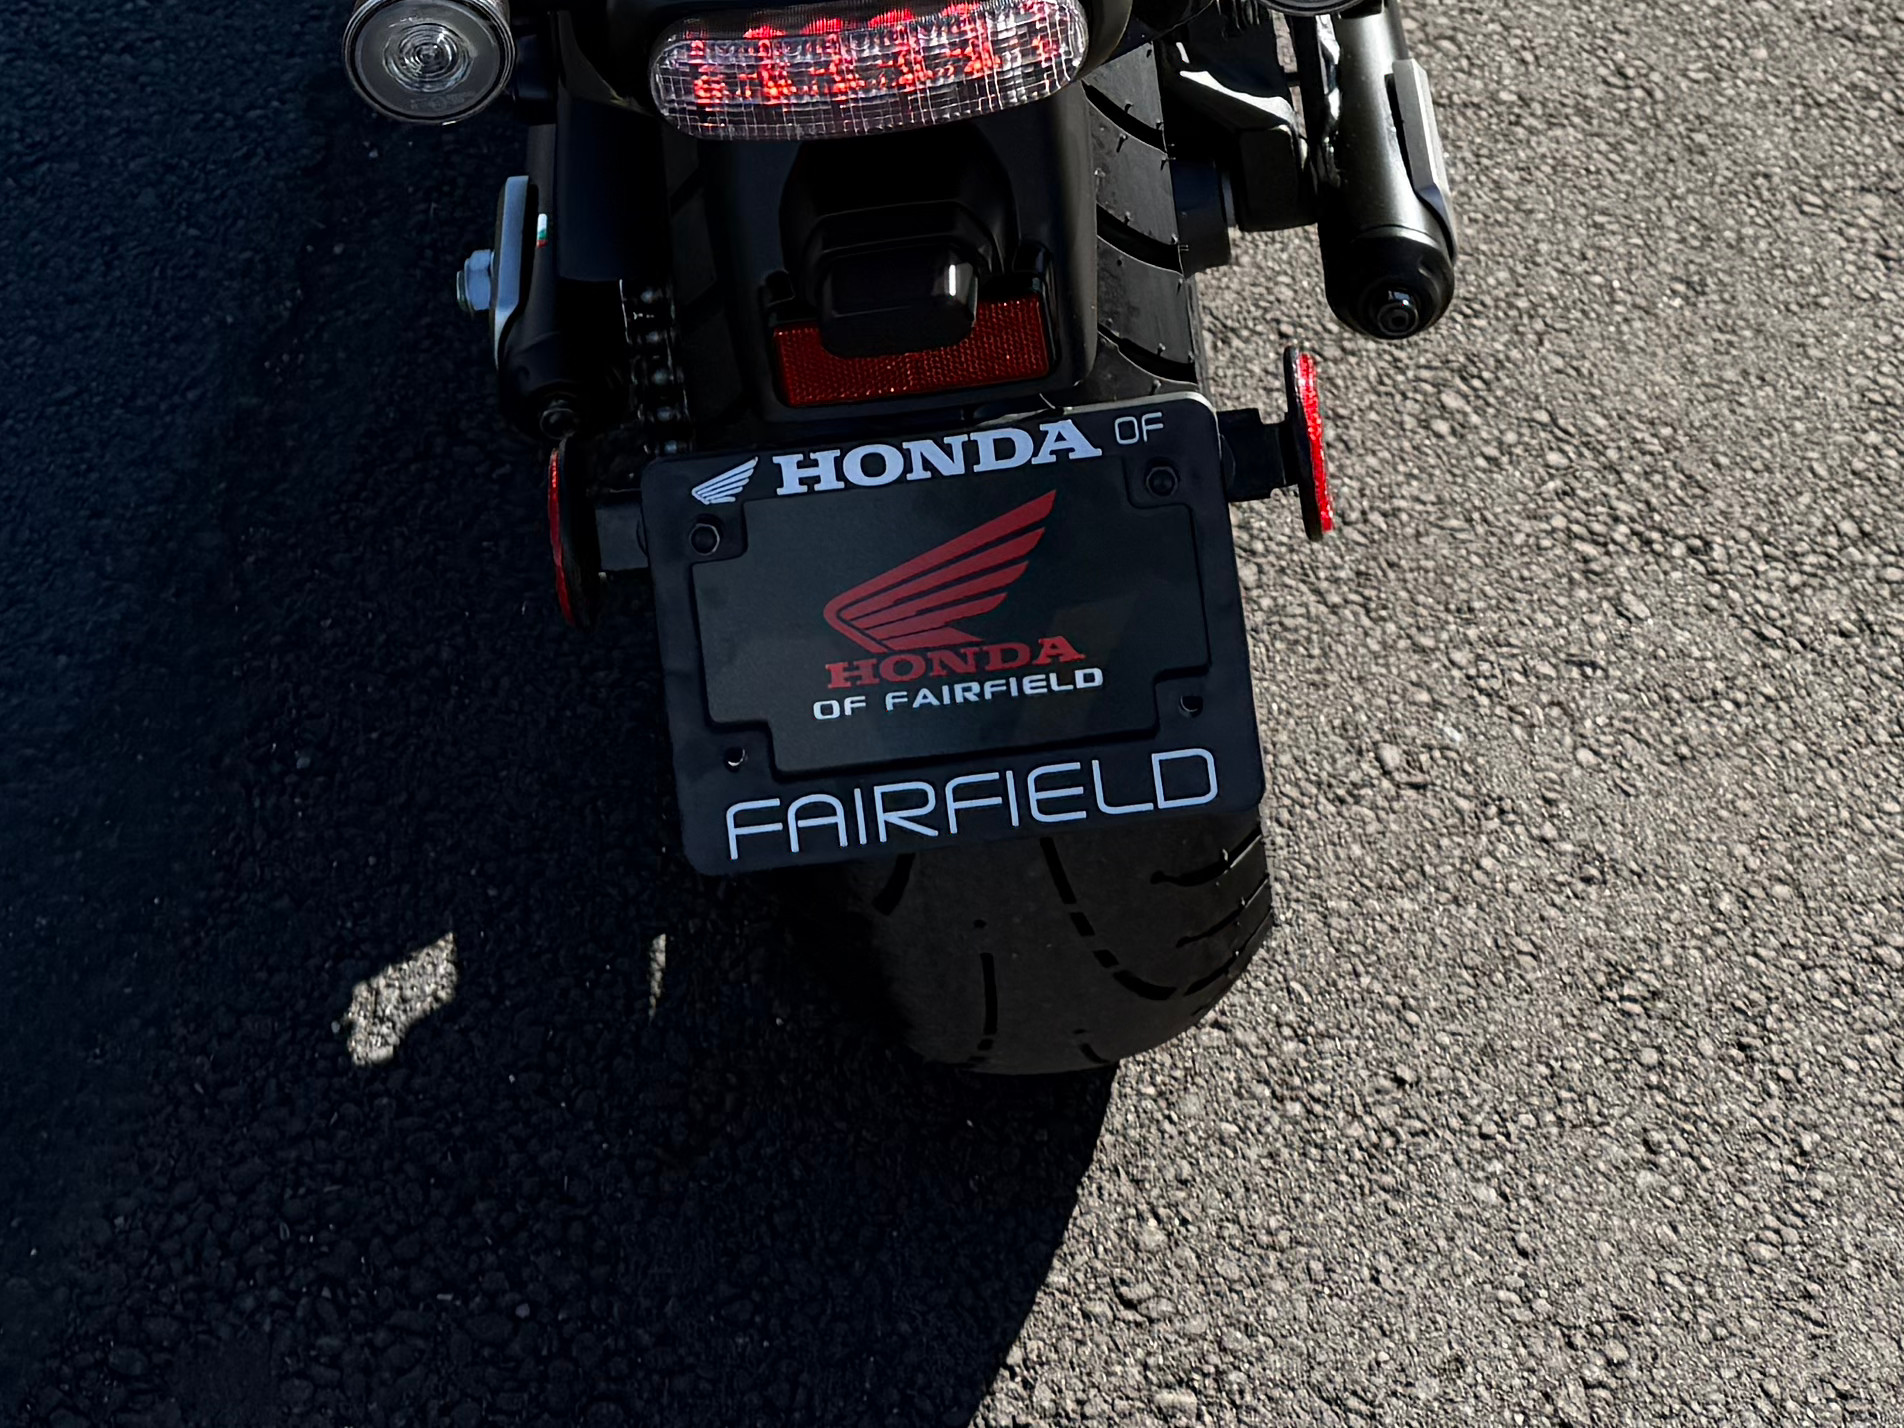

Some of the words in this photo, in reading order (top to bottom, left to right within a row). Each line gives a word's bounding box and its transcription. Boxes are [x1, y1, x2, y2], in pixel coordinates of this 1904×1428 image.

[772, 419, 1102, 497] HONDA
[1114, 412, 1164, 446] OF
[812, 696, 867, 720] OF
[885, 667, 1104, 711] FAIRFIELD
[826, 634, 1086, 690] HONDA
[725, 747, 1218, 860] FAIRFIELD
